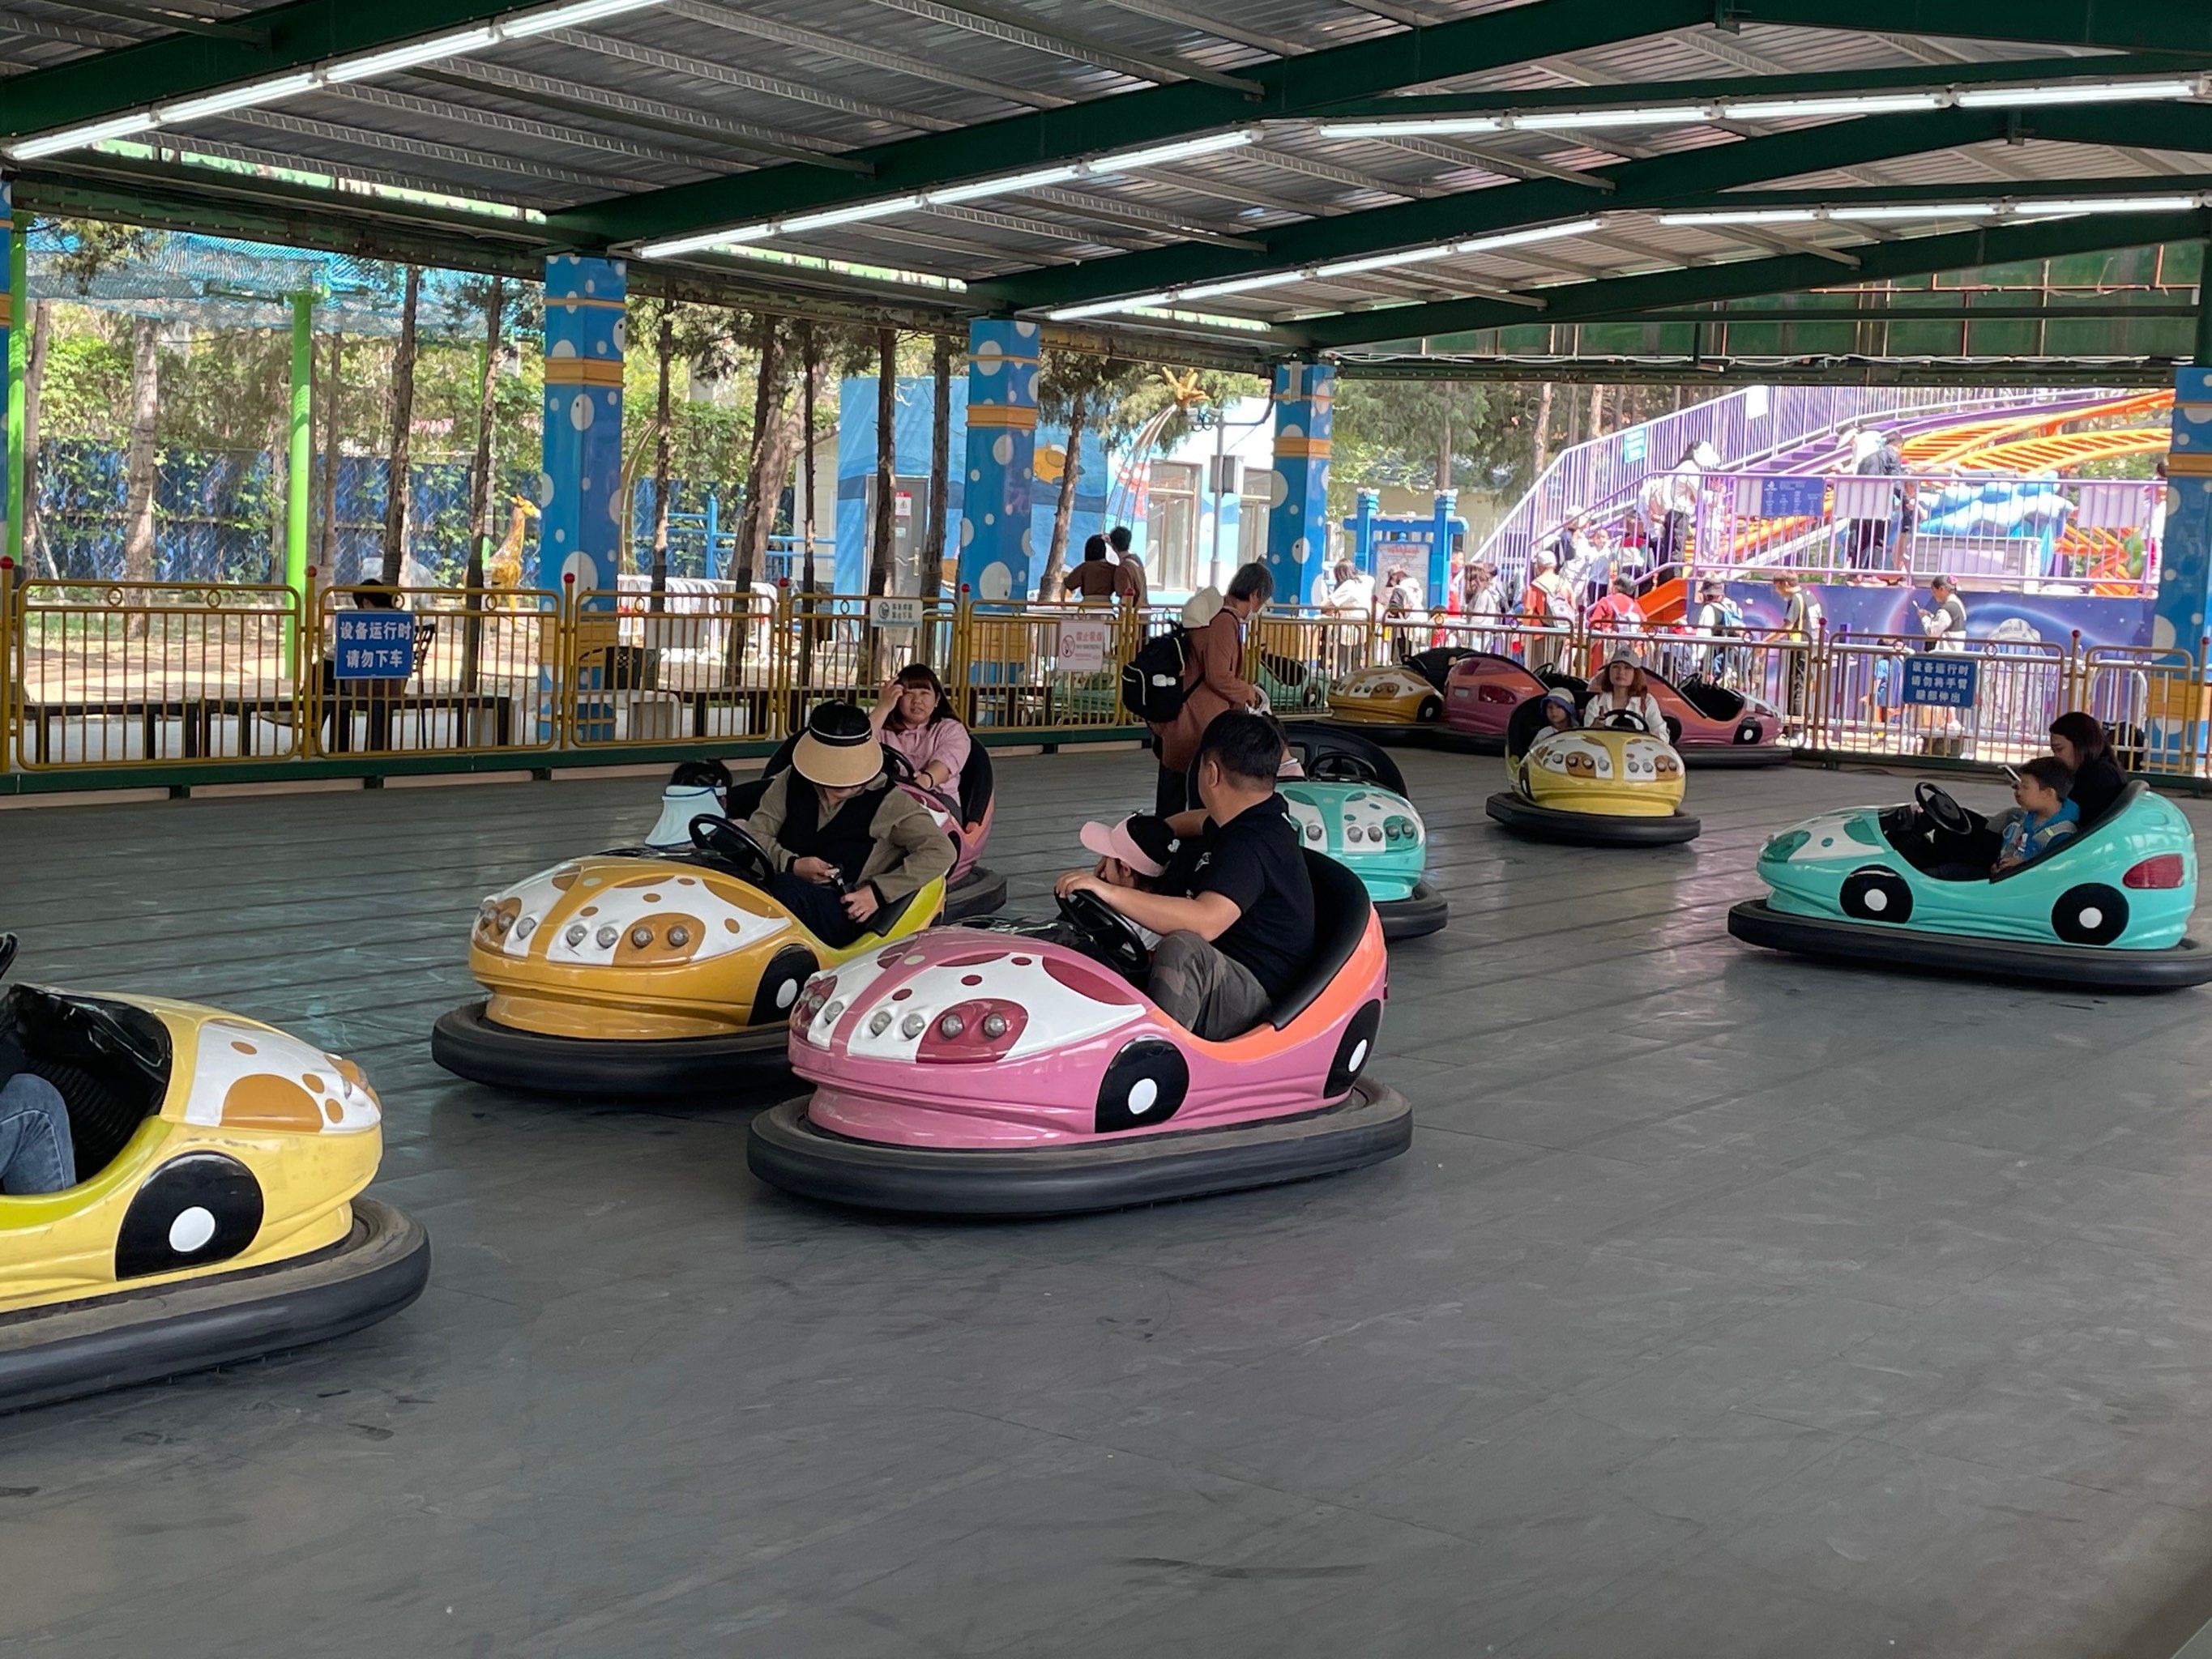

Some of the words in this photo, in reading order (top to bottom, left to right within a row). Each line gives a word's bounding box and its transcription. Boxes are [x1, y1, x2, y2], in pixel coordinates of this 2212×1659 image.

[340, 621, 412, 640] 设备运行时
[346, 649, 403, 668] 请勿下车
